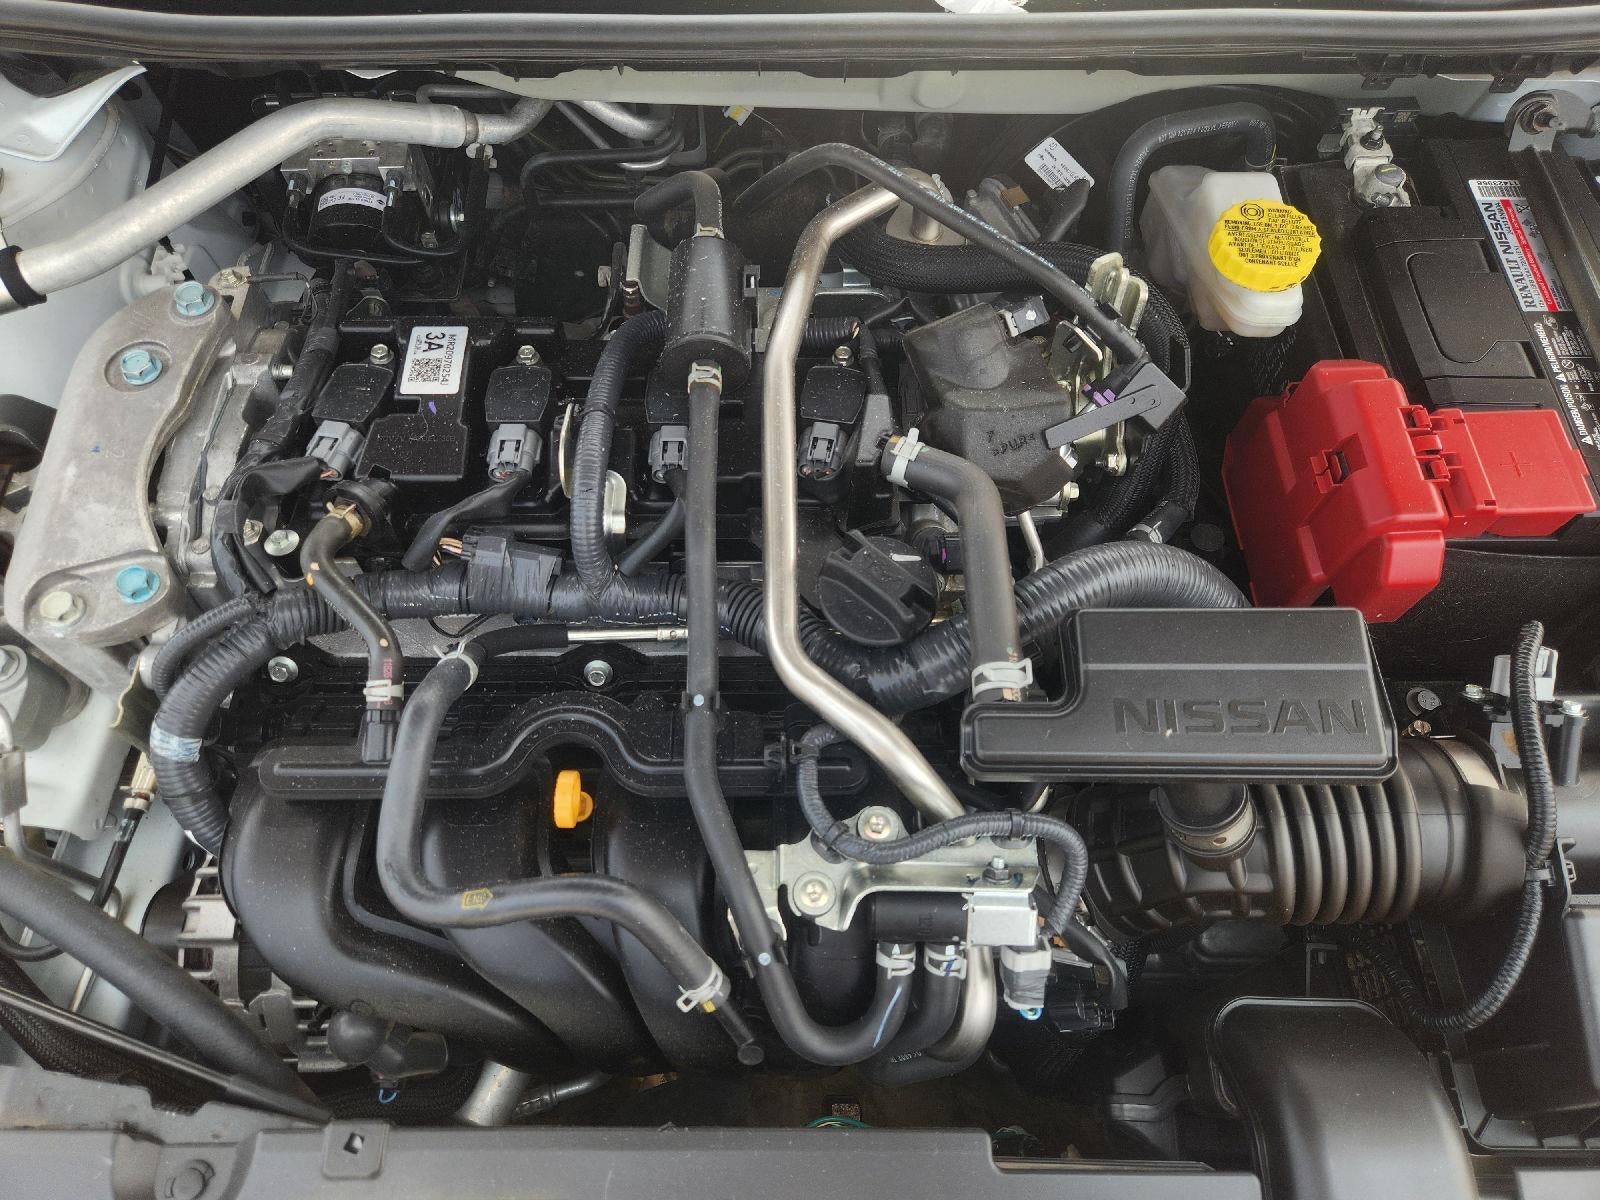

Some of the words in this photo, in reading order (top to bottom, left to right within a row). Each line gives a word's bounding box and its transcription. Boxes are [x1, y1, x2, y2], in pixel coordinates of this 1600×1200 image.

[1482, 202, 1514, 254] NISSAN
[1506, 258, 1537, 308] RENAULT
[423, 332, 446, 352] 3A
[1534, 322, 1561, 373] PELIGRO/VENENO
[1560, 384, 1588, 436] DANGER/POISON
[1113, 699, 1367, 735] NISSAN
